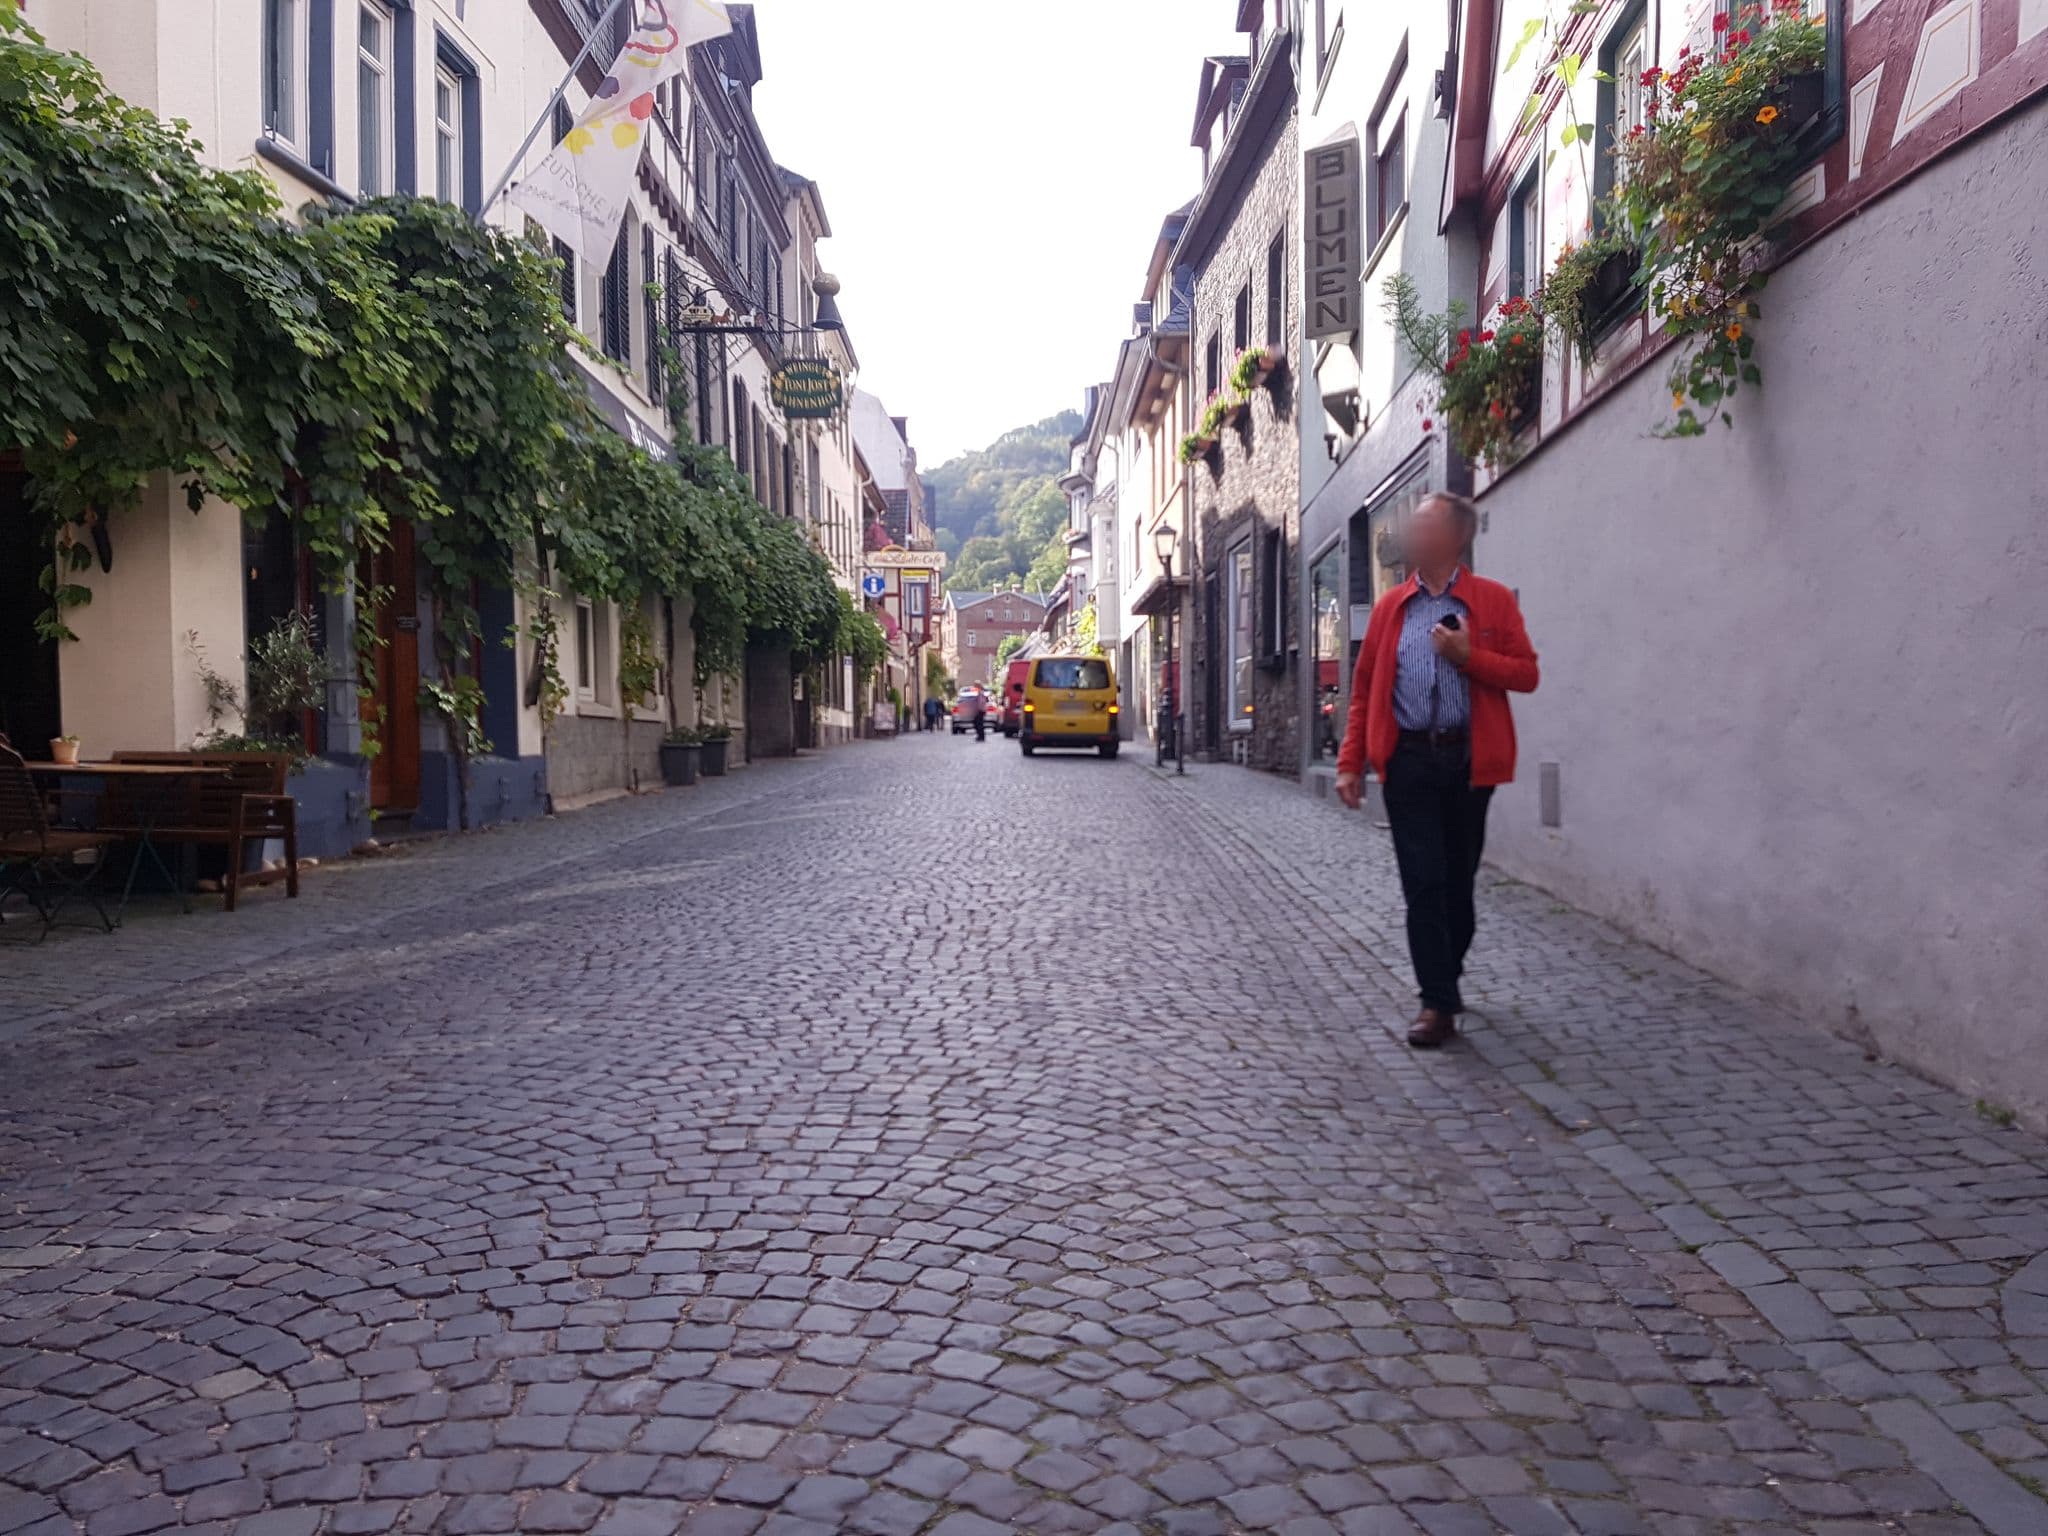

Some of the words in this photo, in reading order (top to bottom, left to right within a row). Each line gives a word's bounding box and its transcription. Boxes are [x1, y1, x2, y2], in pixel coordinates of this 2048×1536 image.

[541, 153, 606, 213] EUTSCHE
[1316, 149, 1346, 328] BLUMEN
[784, 377, 807, 392] TONI
[807, 378, 830, 394] JOST
[785, 361, 827, 376] WEINGUT
